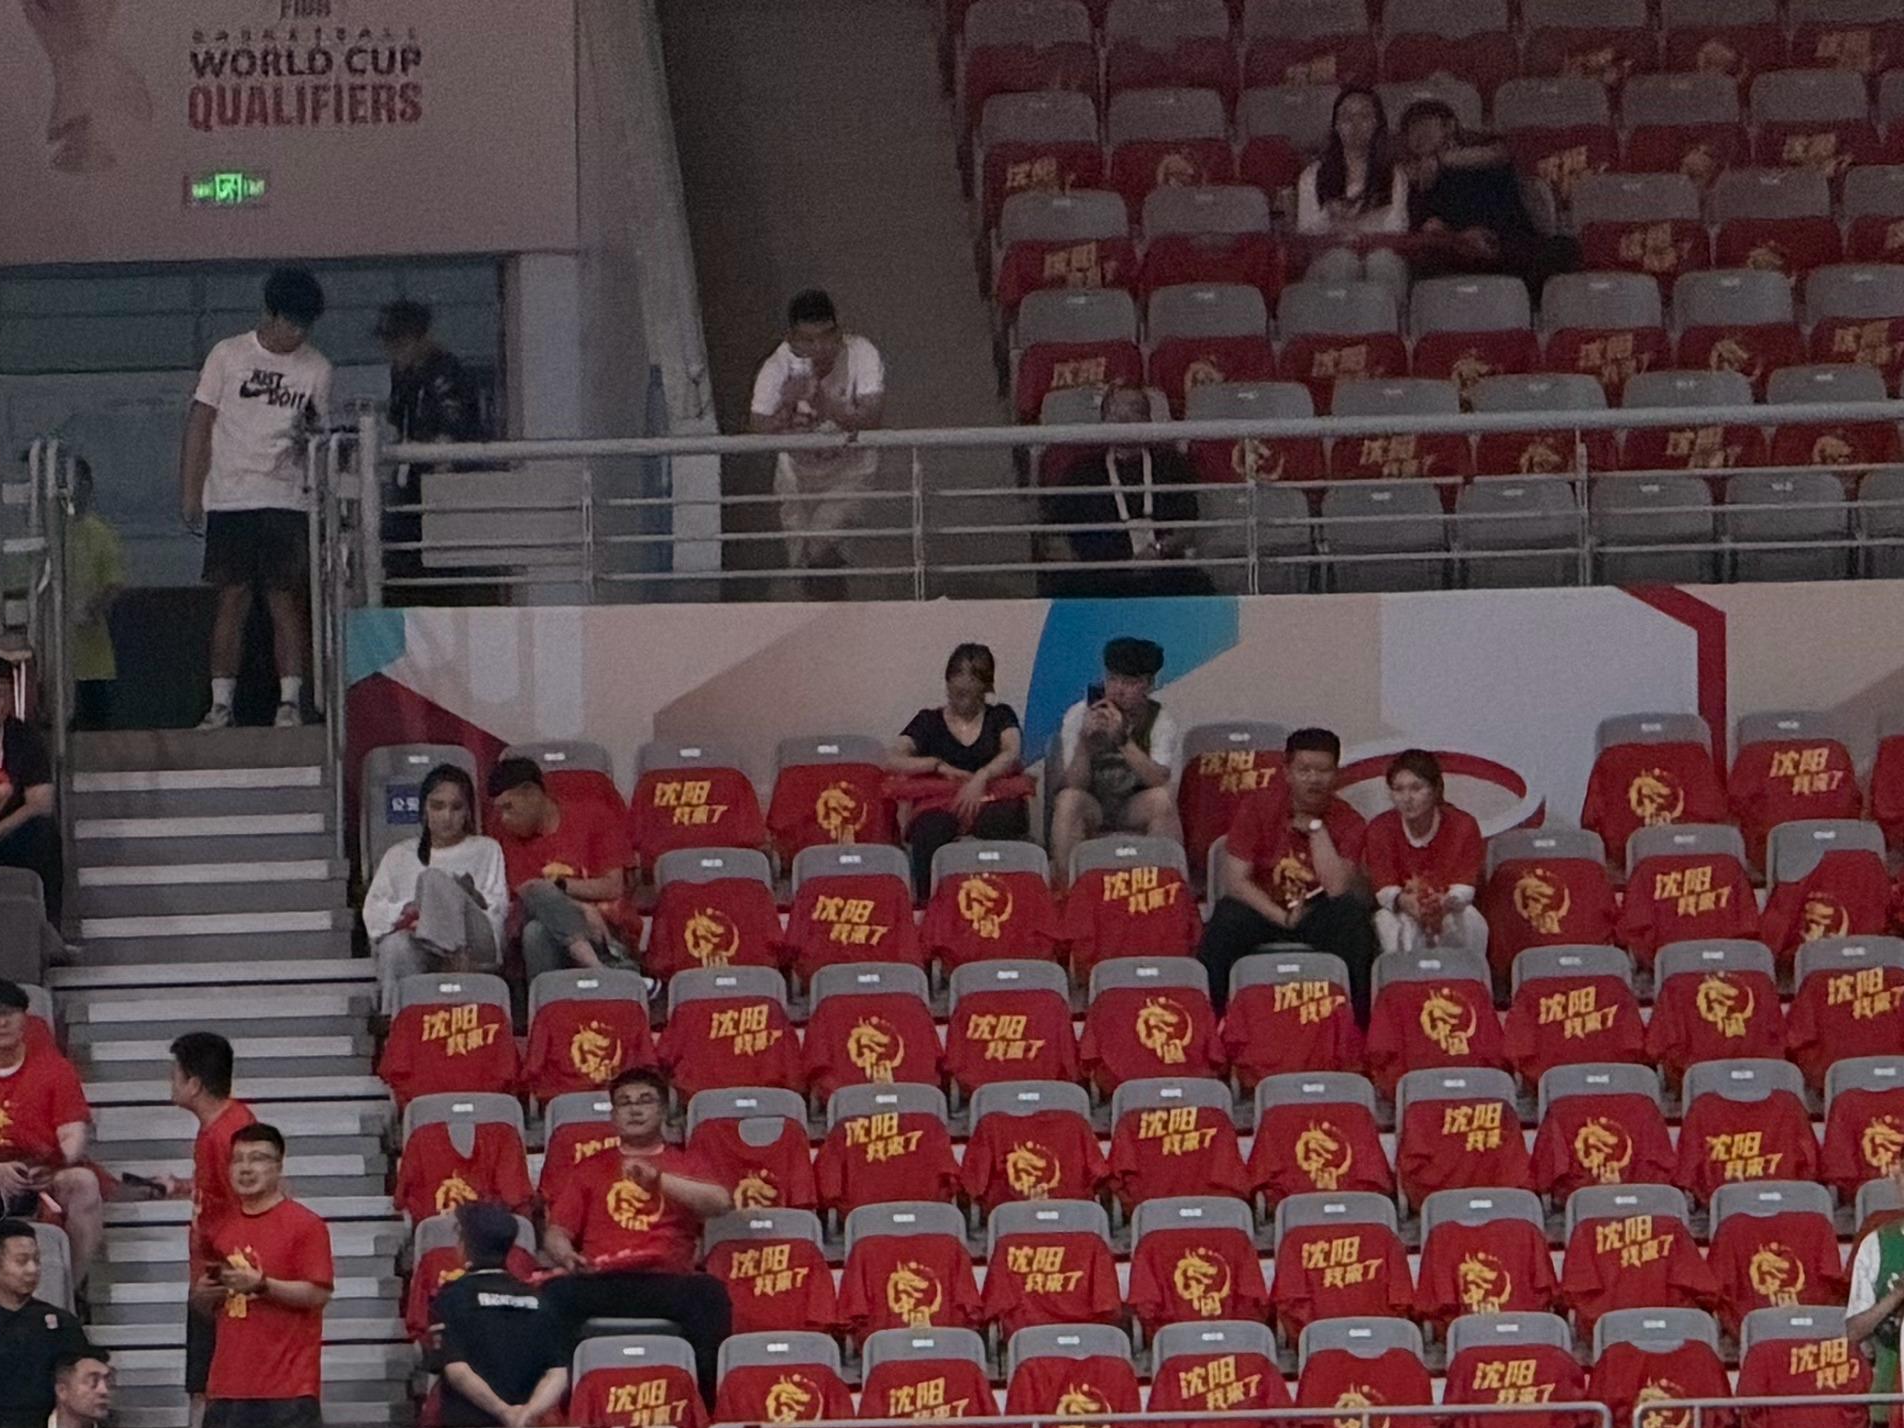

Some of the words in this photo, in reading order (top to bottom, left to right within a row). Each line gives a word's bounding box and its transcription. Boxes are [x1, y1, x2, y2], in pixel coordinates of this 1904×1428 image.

[191, 47, 334, 78] WORLD
[344, 47, 422, 77] CUP
[188, 82, 423, 132] QUALIFIERS
[654, 781, 711, 806] 沈阳
[1103, 866, 1159, 900] 沈阳
[1654, 866, 1712, 899] 沈阳
[812, 895, 872, 923] 沈阳
[710, 1004, 768, 1038] 沈阳
[1539, 986, 1596, 1024] 沈阳
[421, 1004, 478, 1041] 沈阳
[967, 1014, 1027, 1040] 沈阳
[845, 1113, 899, 1146] 沈阳
[1139, 1107, 1198, 1138] 沈阳
[1706, 1132, 1762, 1160] 沈阳
[1596, 1213, 1652, 1253] 沈阳
[731, 1245, 789, 1279] 沈阳
[1008, 1246, 1065, 1273] 沈阳
[1302, 1236, 1360, 1269] 沈阳
[1179, 1356, 1237, 1396] 沈阳
[1473, 1360, 1537, 1390] 沈阳
[606, 1379, 667, 1414] 沈阳
